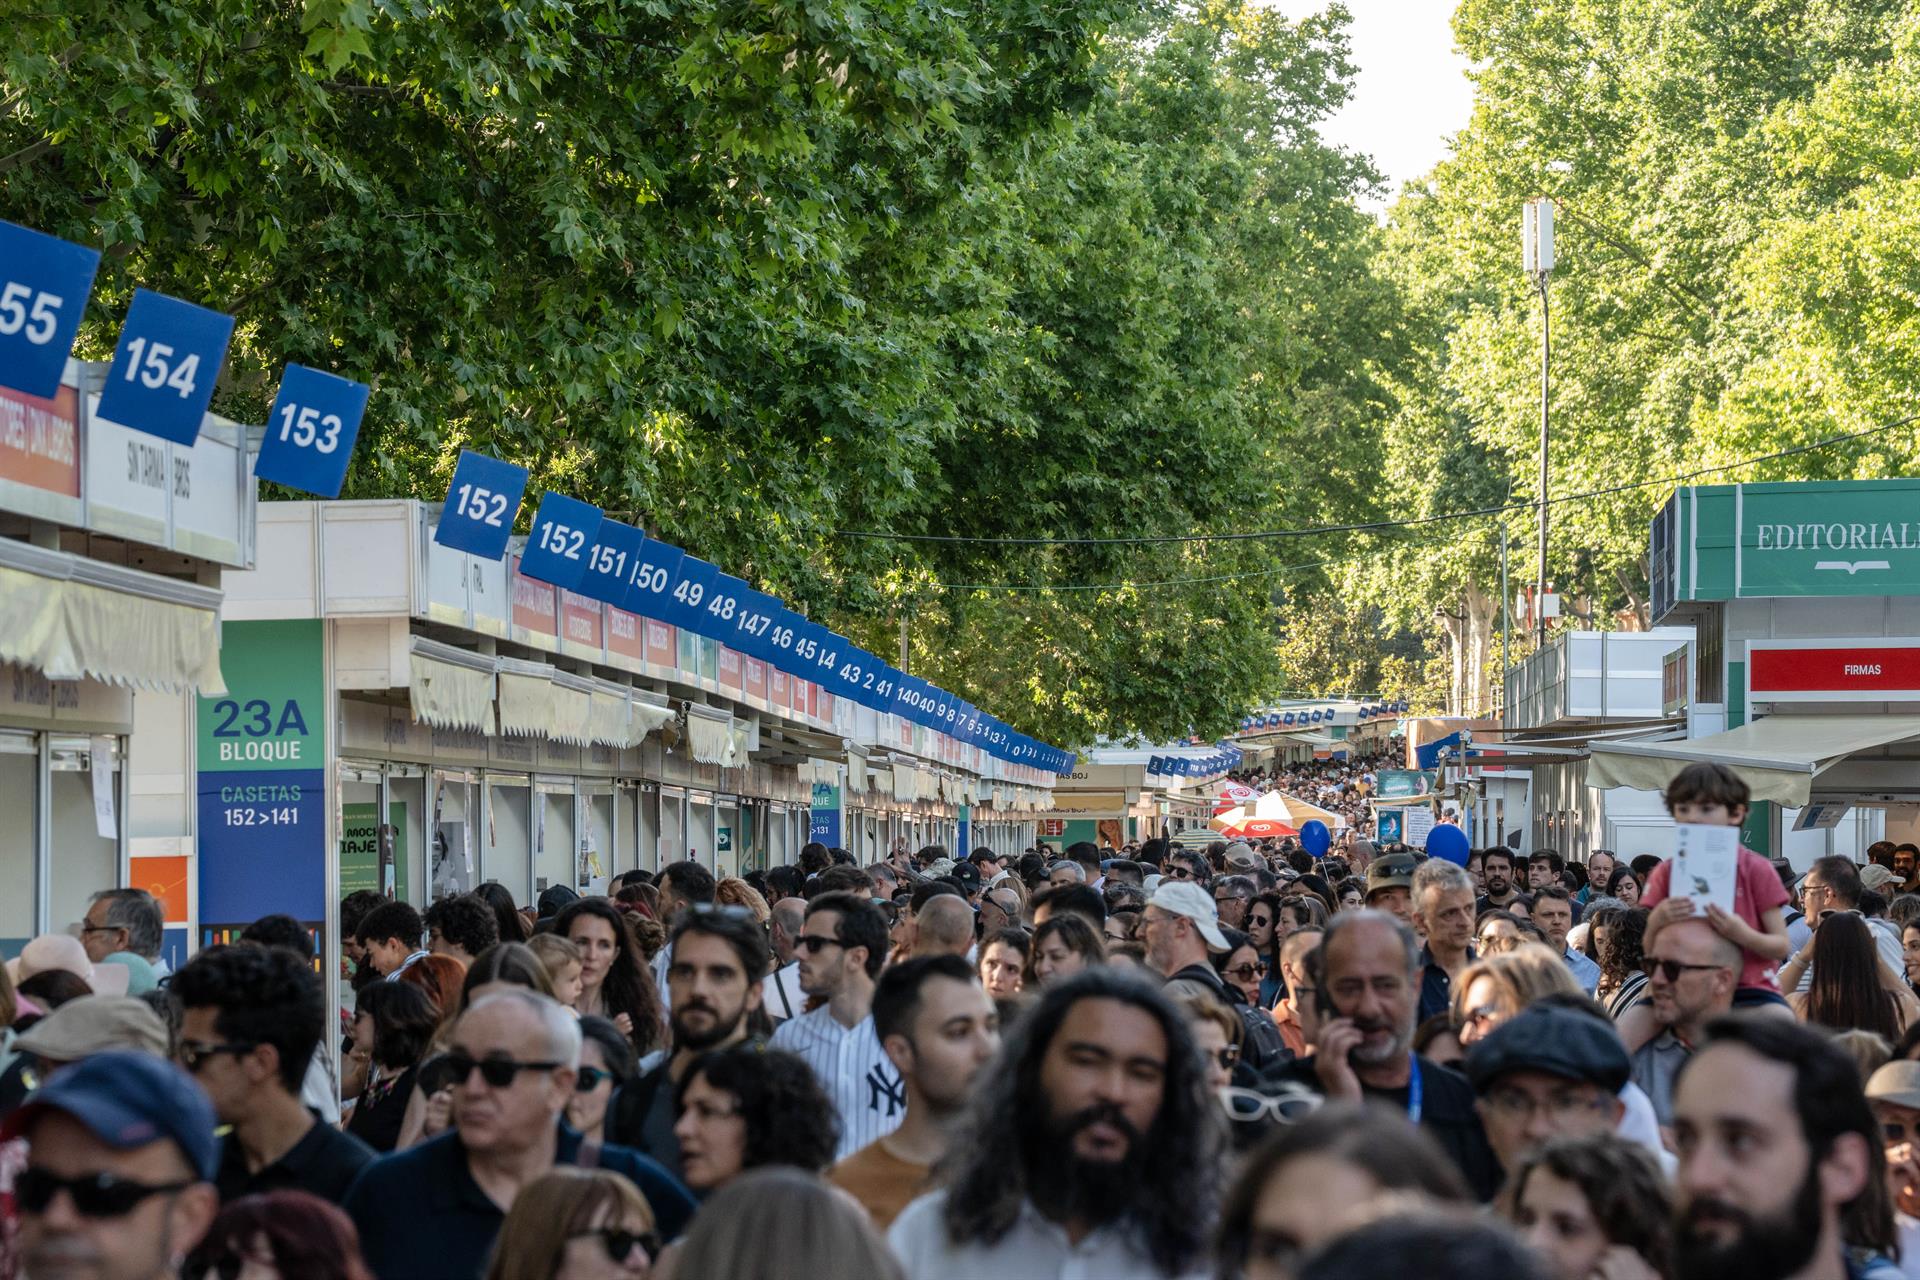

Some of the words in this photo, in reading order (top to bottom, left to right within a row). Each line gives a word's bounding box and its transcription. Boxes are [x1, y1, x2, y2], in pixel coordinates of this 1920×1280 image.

[125, 337, 200, 399] 154
[280, 403, 342, 453] 153
[458, 484, 508, 527] 152
[540, 521, 585, 560] 152
[1757, 522, 1920, 550] EDITORIAL
[589, 544, 627, 577] 151
[673, 579, 704, 606] 49
[708, 594, 736, 620] 48
[737, 610, 771, 636] 147
[795, 638, 818, 659] 45
[839, 663, 861, 683] 43
[1844, 664, 1882, 675] FIRMAS
[862, 673, 875, 690] 2
[876, 679, 893, 697] 41
[897, 687, 920, 706] 140
[919, 697, 935, 713] 40
[213, 699, 309, 737] 23A
[946, 709, 956, 722] 8
[967, 719, 975, 731] 6
[220, 741, 301, 761] BLOQUE
[221, 785, 302, 803] CASETAS
[866, 1063, 907, 1116] NY
